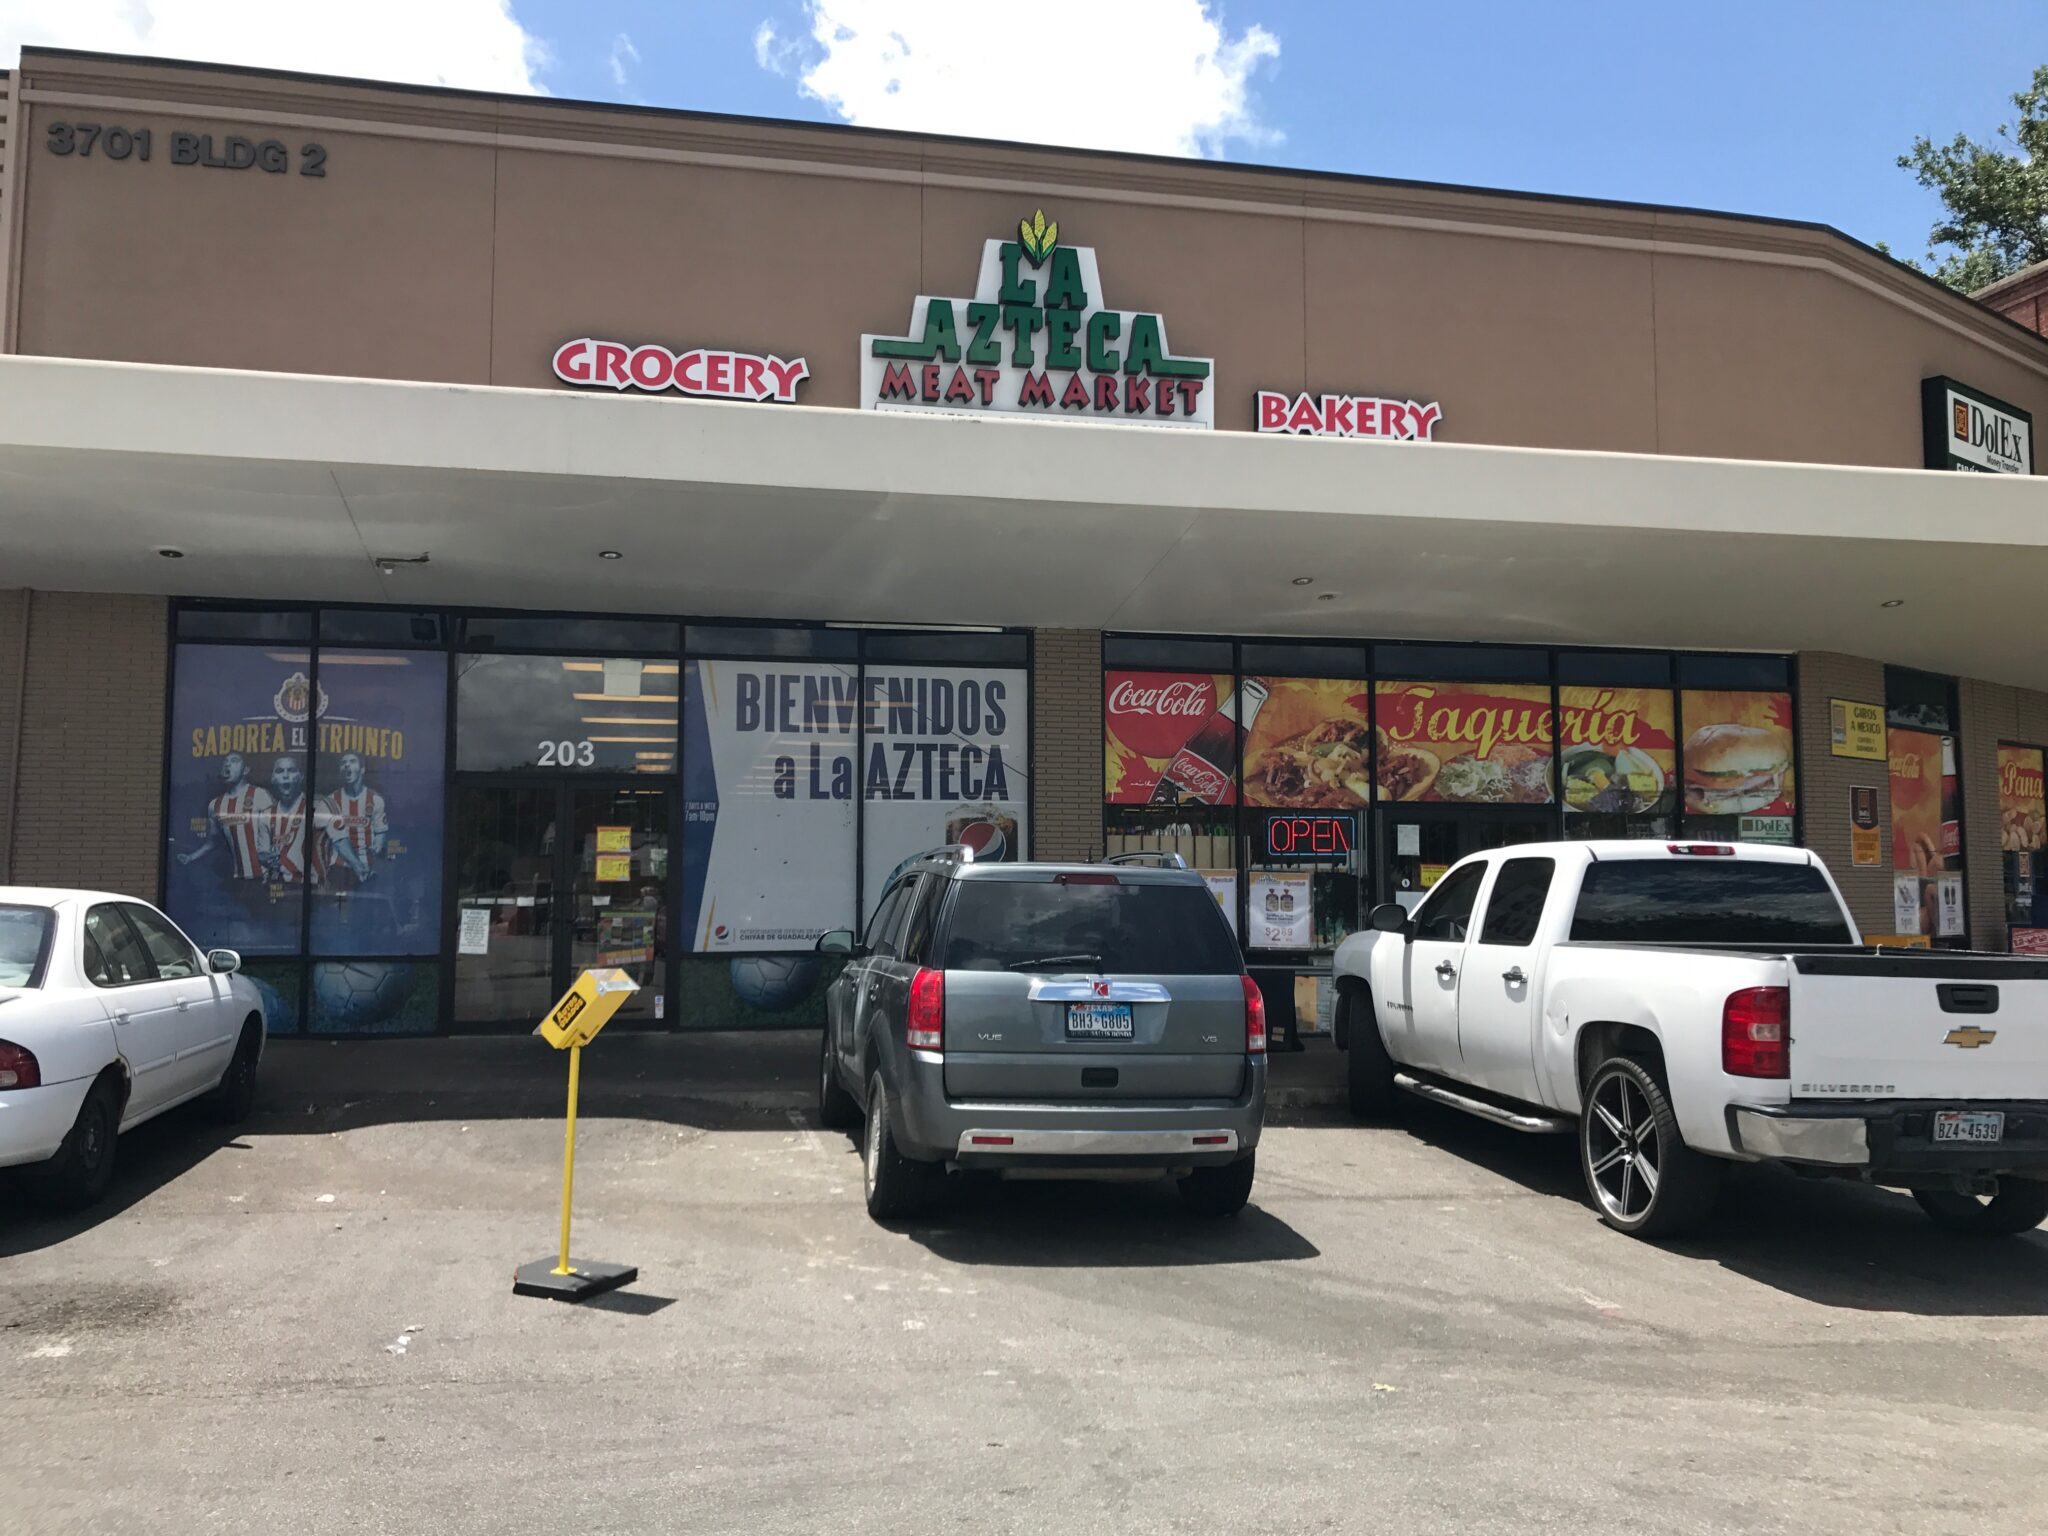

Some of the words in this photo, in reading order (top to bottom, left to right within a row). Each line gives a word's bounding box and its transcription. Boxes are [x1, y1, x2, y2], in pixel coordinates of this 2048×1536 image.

[46, 121, 151, 162] 3701
[170, 131, 288, 175] BLDG
[300, 143, 327, 178] 2
[998, 242, 1088, 309] LA
[872, 299, 1210, 377] AZTECA
[555, 339, 806, 400] GROCERY
[878, 361, 1000, 406] MEAT
[1017, 371, 1204, 416] MARKET
[1259, 391, 1438, 440] BAKERY
[1970, 404, 2023, 464] DolEx
[735, 673, 1008, 737] BIENVENIDOS
[1108, 680, 1212, 716] Coca-Cola
[1388, 685, 1641, 759] Taquería
[191, 722, 286, 758] SABOREA
[291, 727, 307, 747] EL
[319, 723, 404, 760] TRIUNFO
[537, 740, 596, 767] 203
[774, 755, 796, 800] a
[809, 741, 853, 800] La
[866, 742, 1010, 801] AZTECA
[1173, 757, 1222, 795] Coca-Cola
[1270, 819, 1350, 853] OPEN
[1755, 819, 1791, 833] DolEx
[978, 1033, 1003, 1041] VUE
[1202, 1034, 1218, 1043] V6
[1801, 1083, 1896, 1094] SILVERADO
